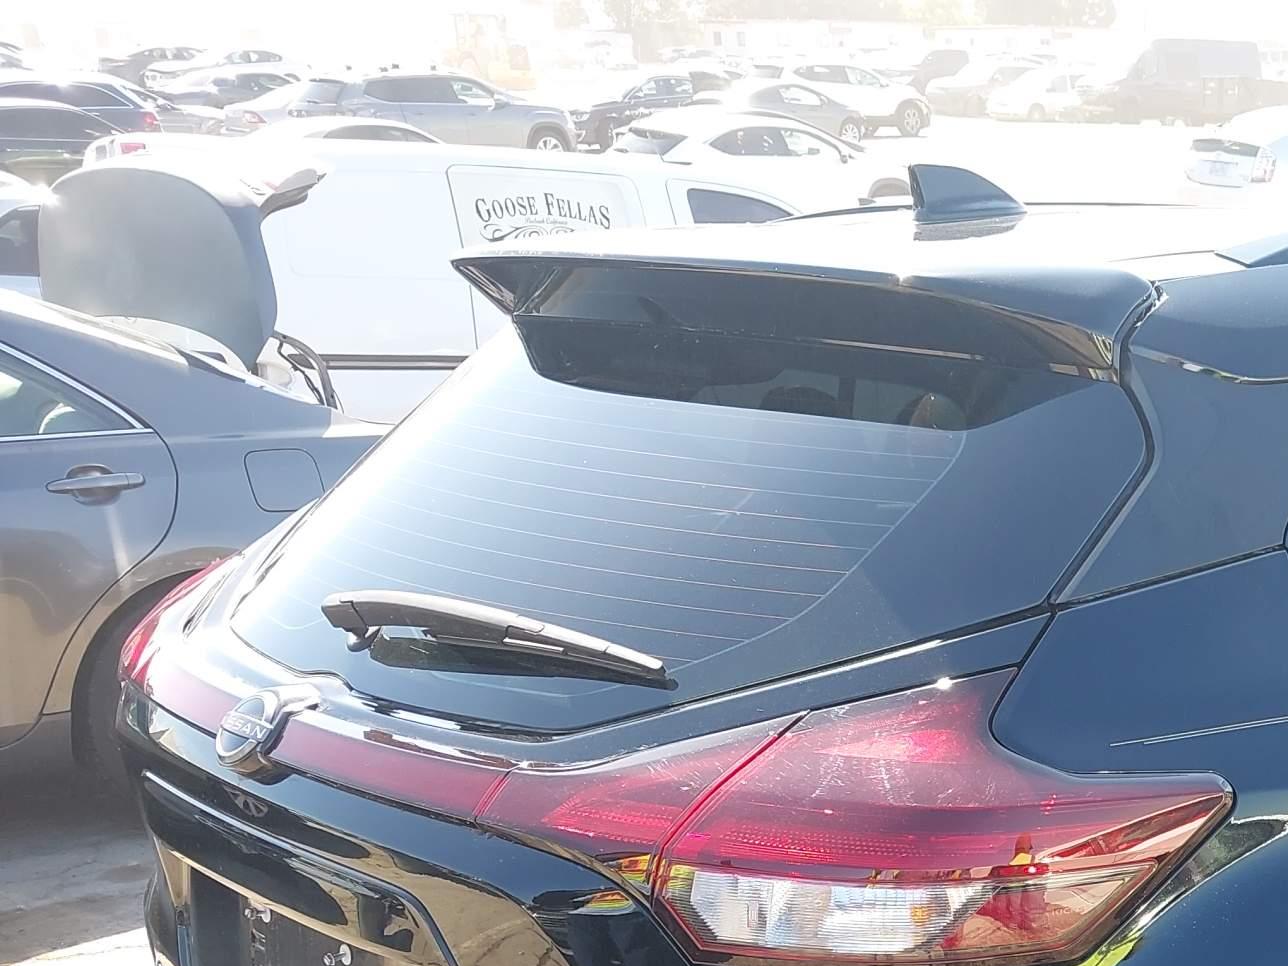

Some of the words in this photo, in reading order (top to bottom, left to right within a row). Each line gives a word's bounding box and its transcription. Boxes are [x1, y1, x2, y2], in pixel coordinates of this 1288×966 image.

[475, 196, 538, 223] GOOSE
[544, 192, 611, 230] FELLAS
[223, 712, 267, 739] SSAN
